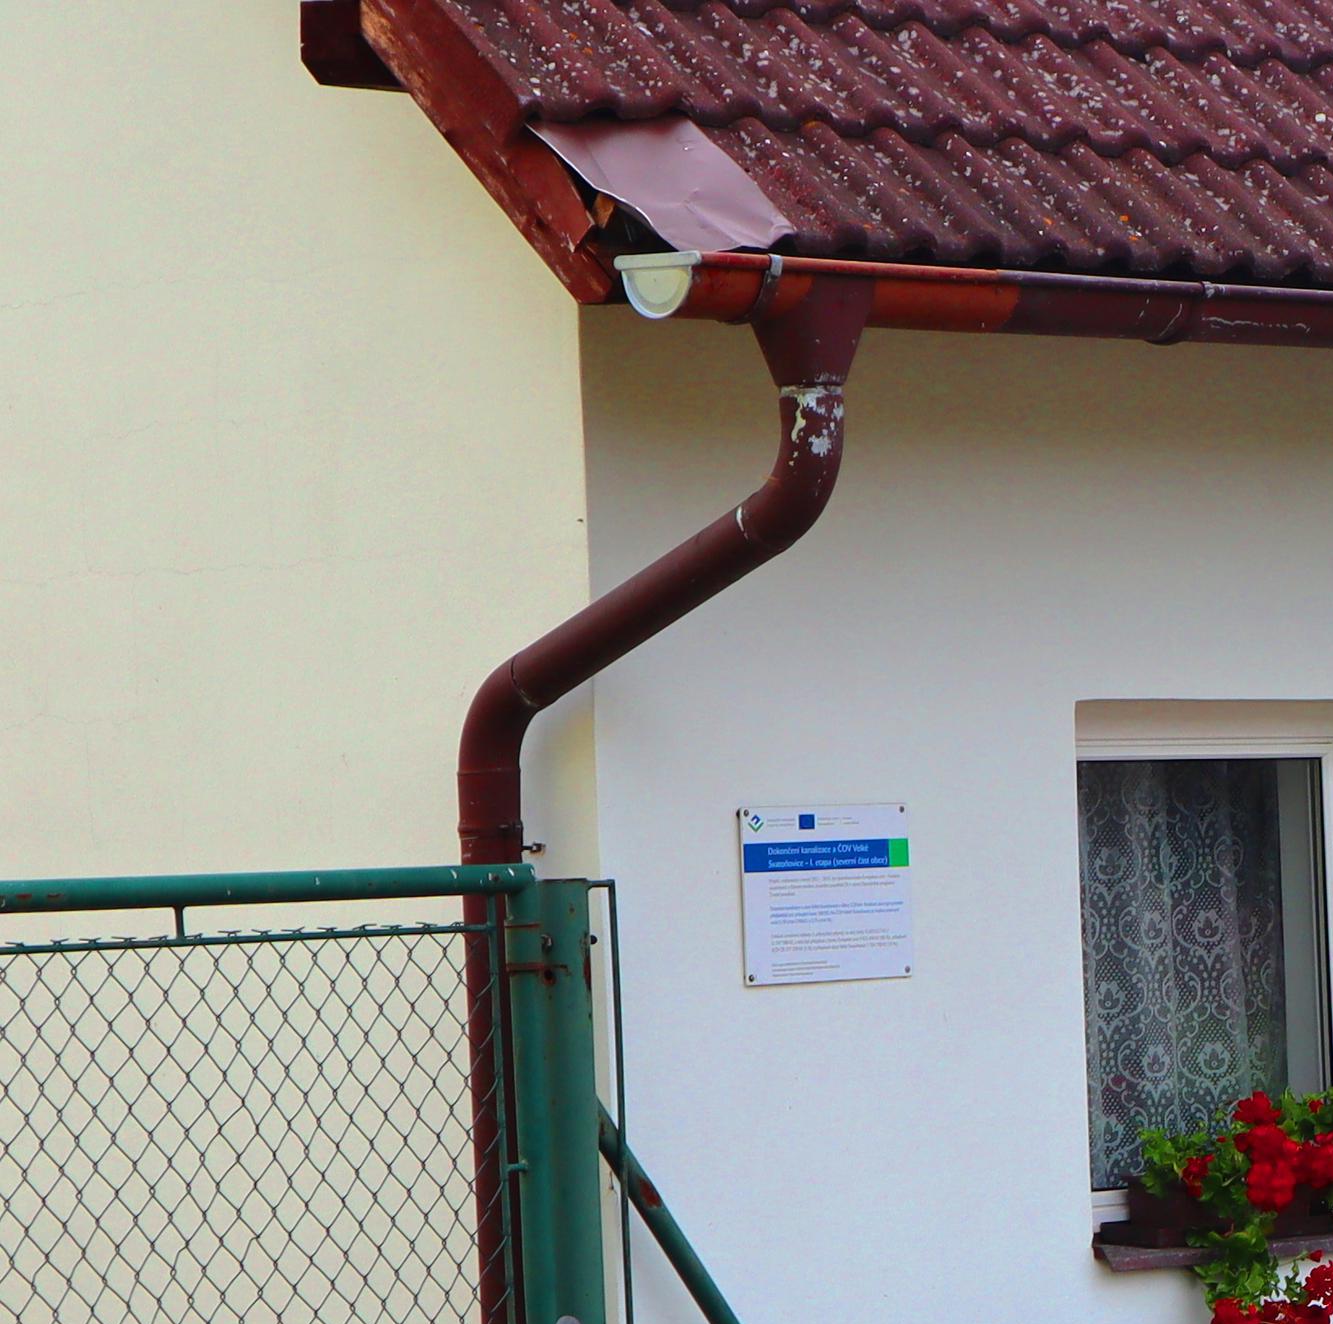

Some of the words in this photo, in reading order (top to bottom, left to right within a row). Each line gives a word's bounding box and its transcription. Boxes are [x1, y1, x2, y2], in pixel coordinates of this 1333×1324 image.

[837, 844, 852, 853] ČOV
[815, 858, 832, 868] etapa
[870, 856, 888, 866] obce)
